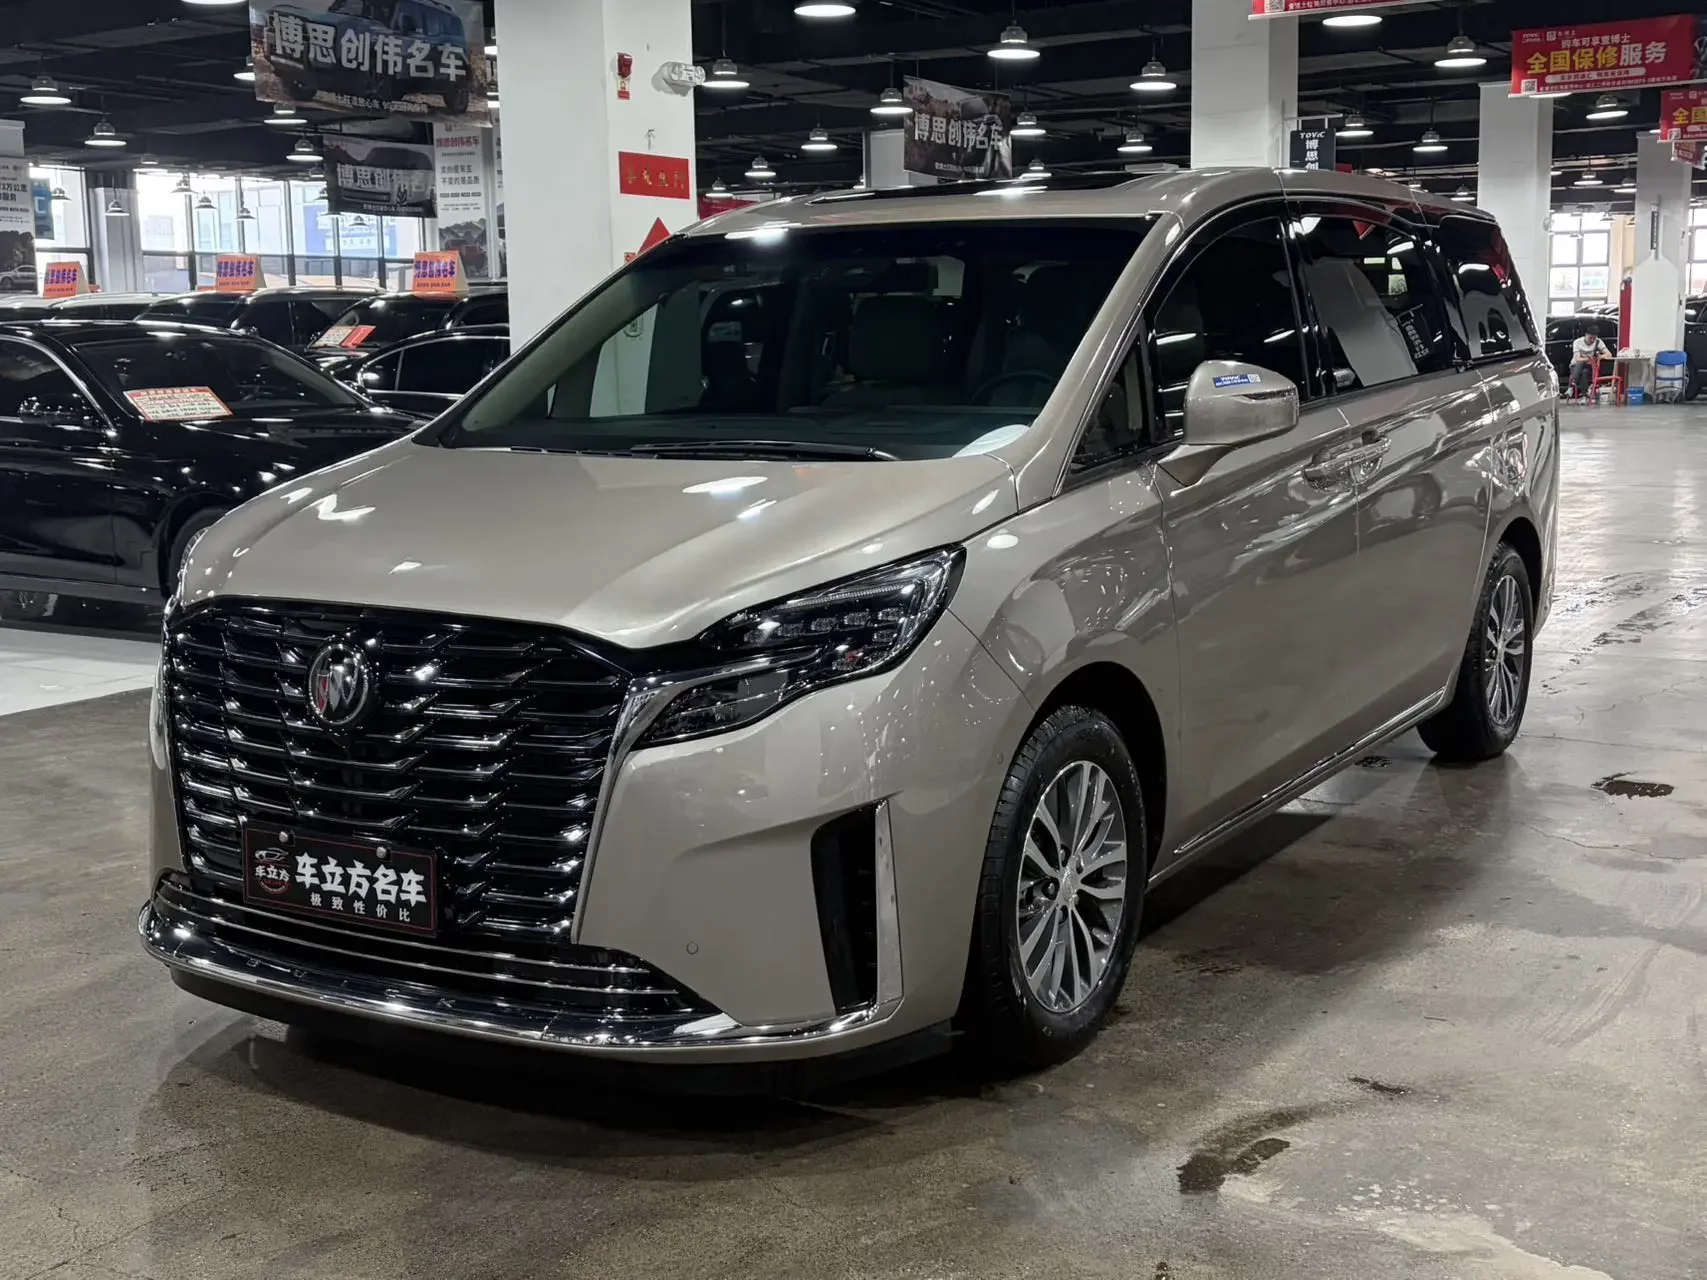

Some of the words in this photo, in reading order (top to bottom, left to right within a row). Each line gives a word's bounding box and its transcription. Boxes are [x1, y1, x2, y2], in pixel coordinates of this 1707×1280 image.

[273, 11, 466, 82] 博思创伟名车
[1527, 41, 1666, 75] 全国保修服务
[914, 111, 1003, 153] 博思创伟名车
[255, 864, 291, 882] 车立方
[295, 852, 427, 907] 车立方名车
[310, 892, 411, 922] 极致性价比
